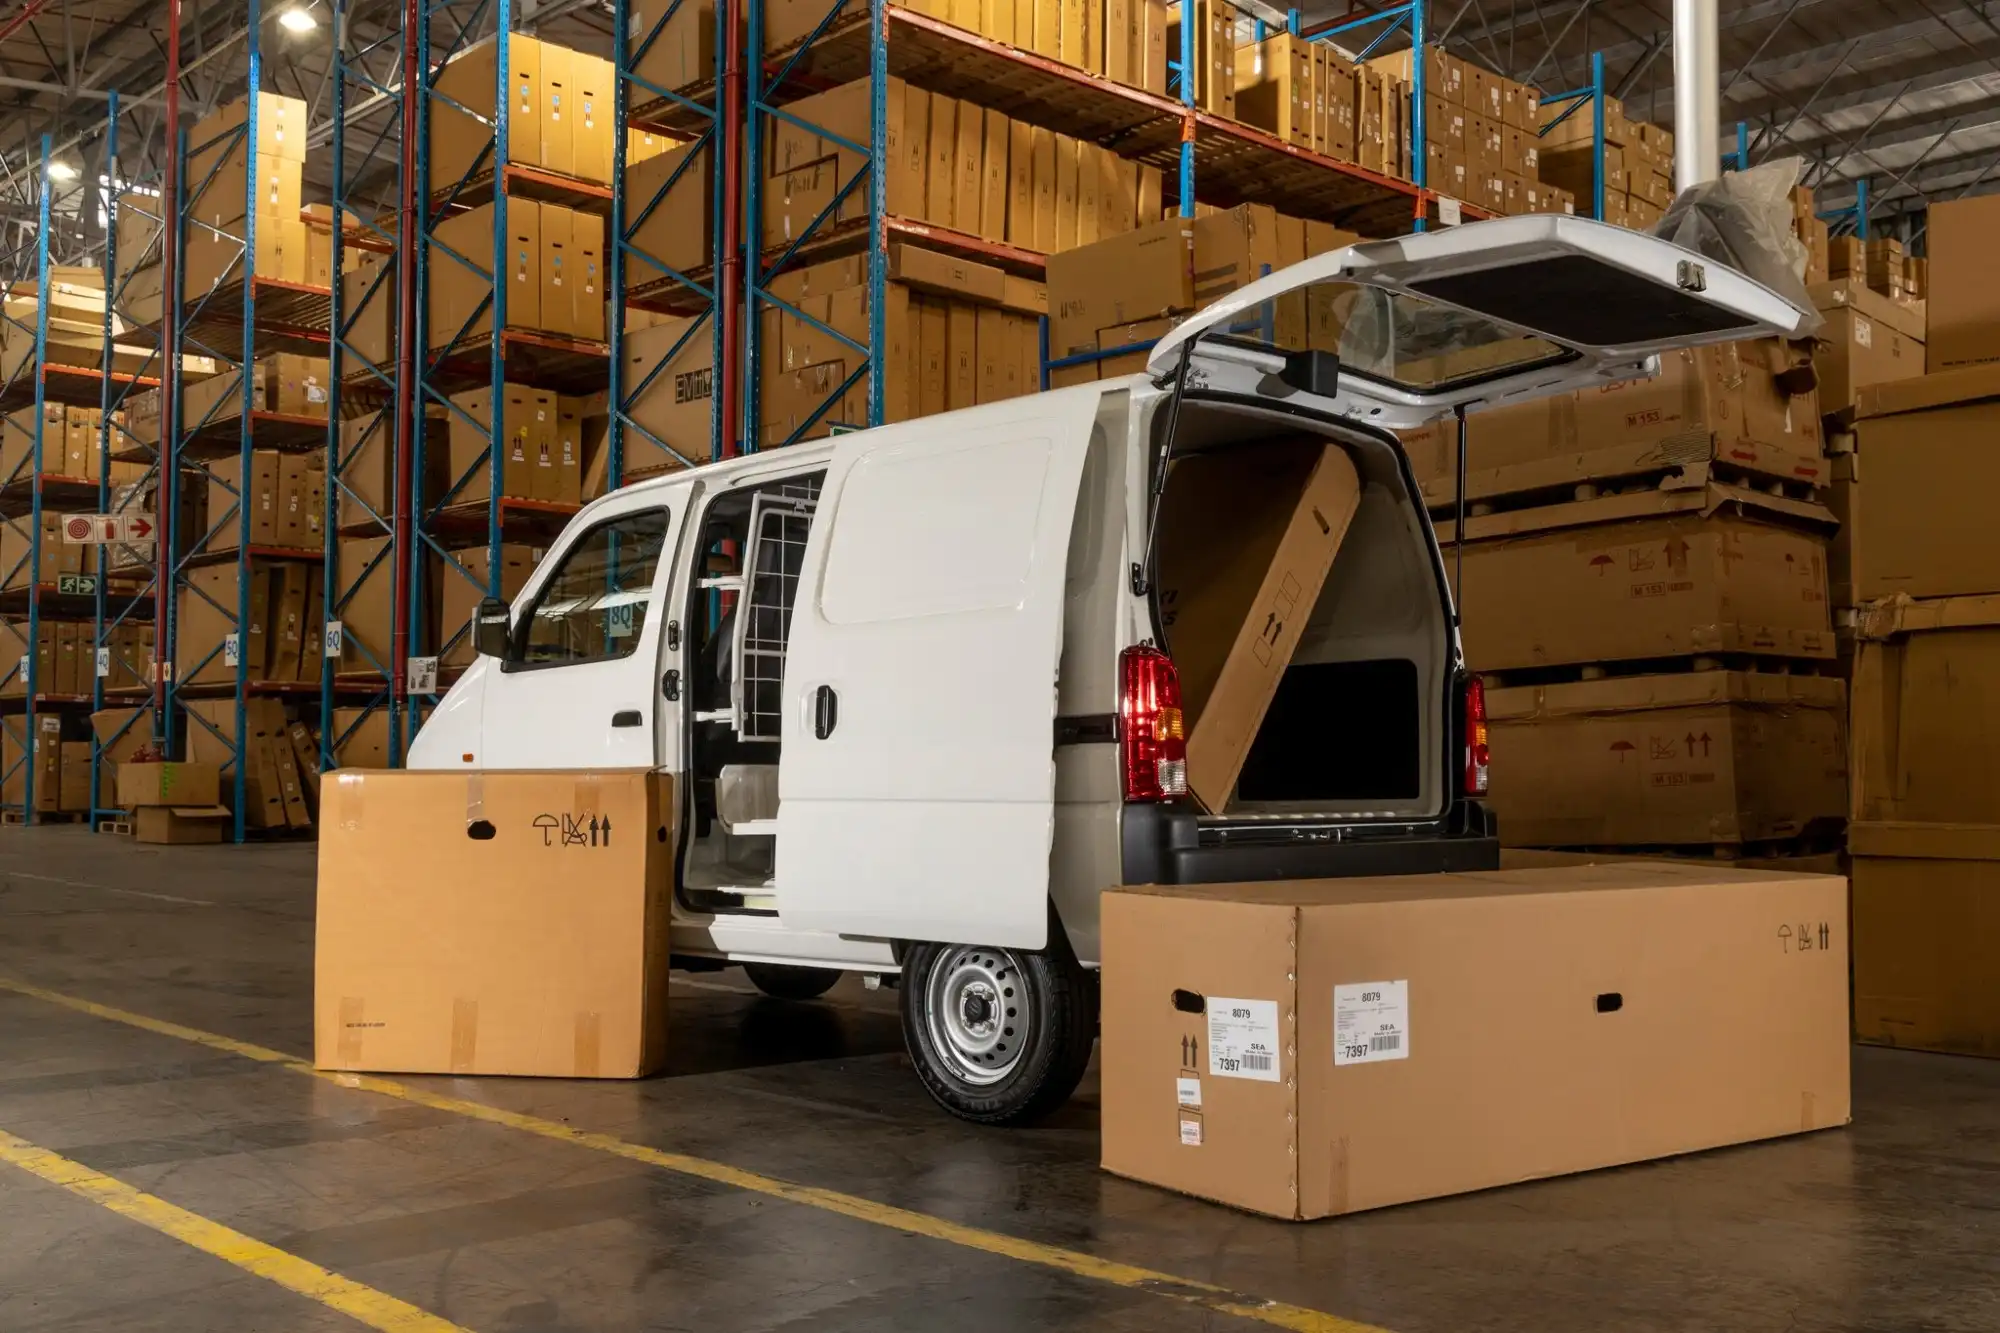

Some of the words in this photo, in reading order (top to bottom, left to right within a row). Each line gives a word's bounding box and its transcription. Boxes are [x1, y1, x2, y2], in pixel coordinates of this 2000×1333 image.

[611, 604, 631, 630] 8Q
[326, 630, 340, 651] 6Q
[1361, 991, 1381, 1002] 8079
[1232, 1008, 1251, 1019] 8079
[1250, 1042, 1266, 1051] SEA
[1345, 1044, 1368, 1058] 7397
[1219, 1057, 1240, 1072] 7397
